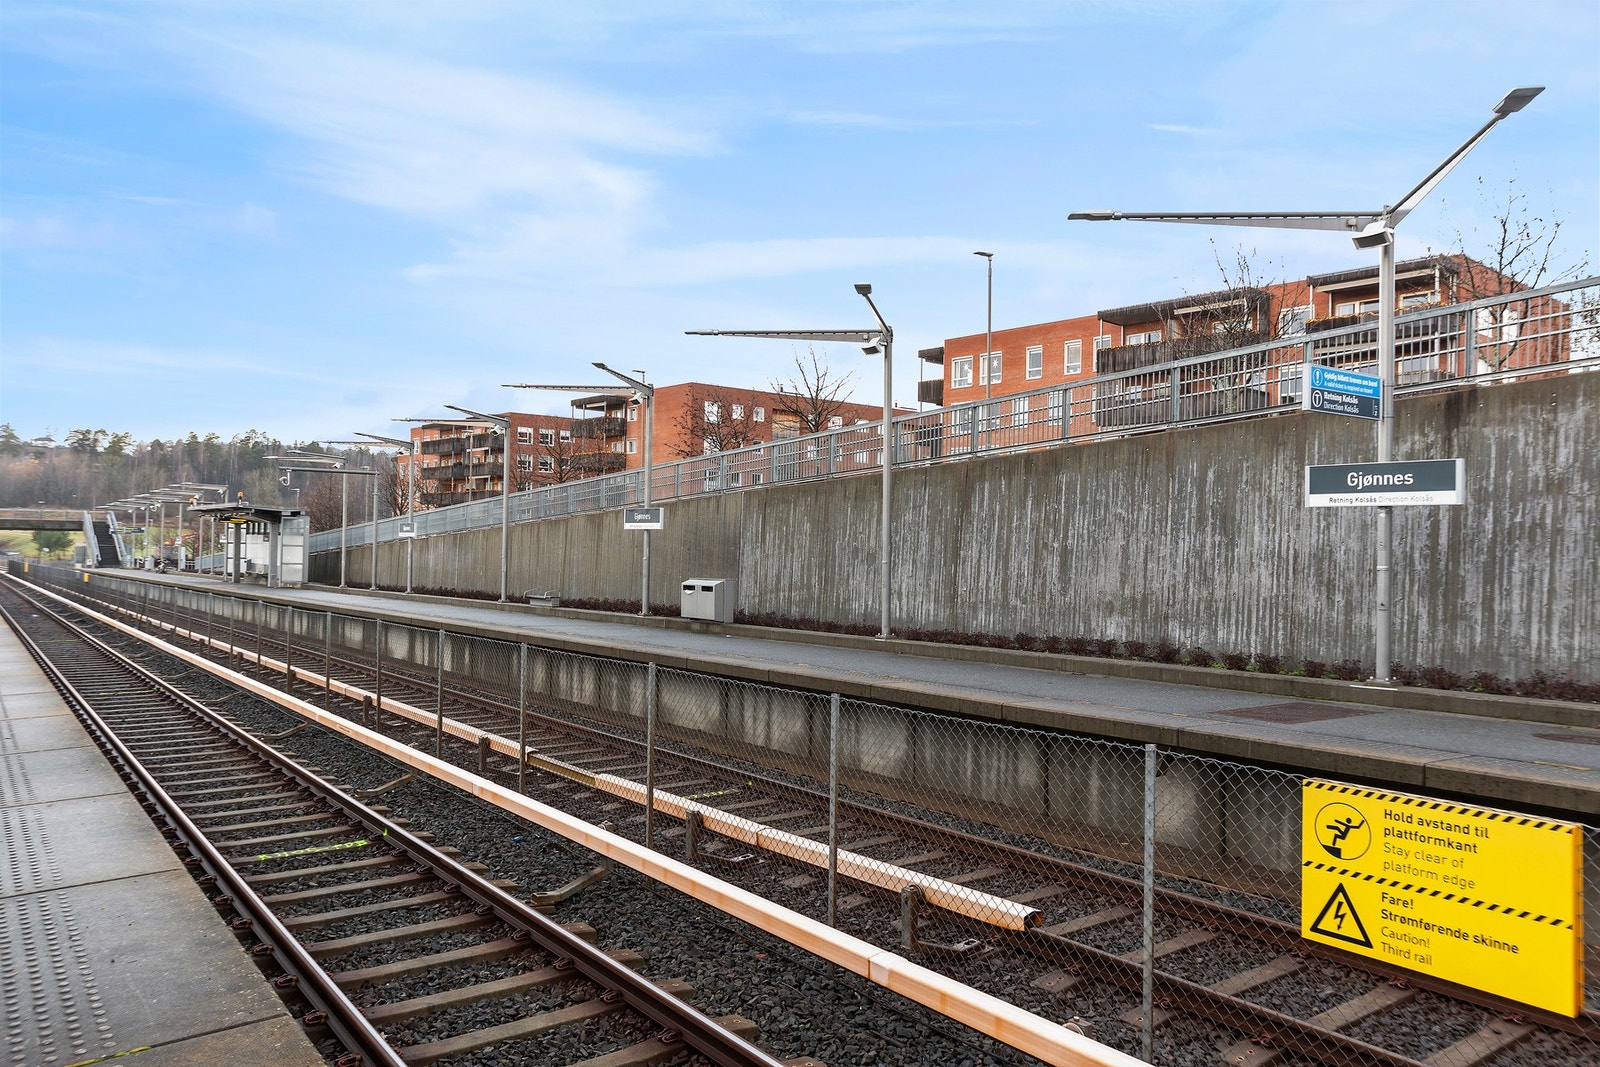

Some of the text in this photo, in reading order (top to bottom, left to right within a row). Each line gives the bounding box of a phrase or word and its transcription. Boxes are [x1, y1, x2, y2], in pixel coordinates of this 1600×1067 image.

[1324, 392, 1358, 404] Retning Kolsås
[1324, 401, 1359, 413] Direction Kolsås
[1347, 472, 1414, 489] Gjønnes
[1384, 809, 1489, 838] Hold avstand til
[1384, 827, 1478, 854] plattformkant
[1384, 842, 1464, 868] Stay clear of
[1384, 861, 1476, 890] platform edge
[1381, 892, 1414, 909] Fare!
[1381, 909, 1519, 954] Strømførende skinne
[1381, 926, 1430, 948] Caution!
[1381, 941, 1432, 965] Third rail
